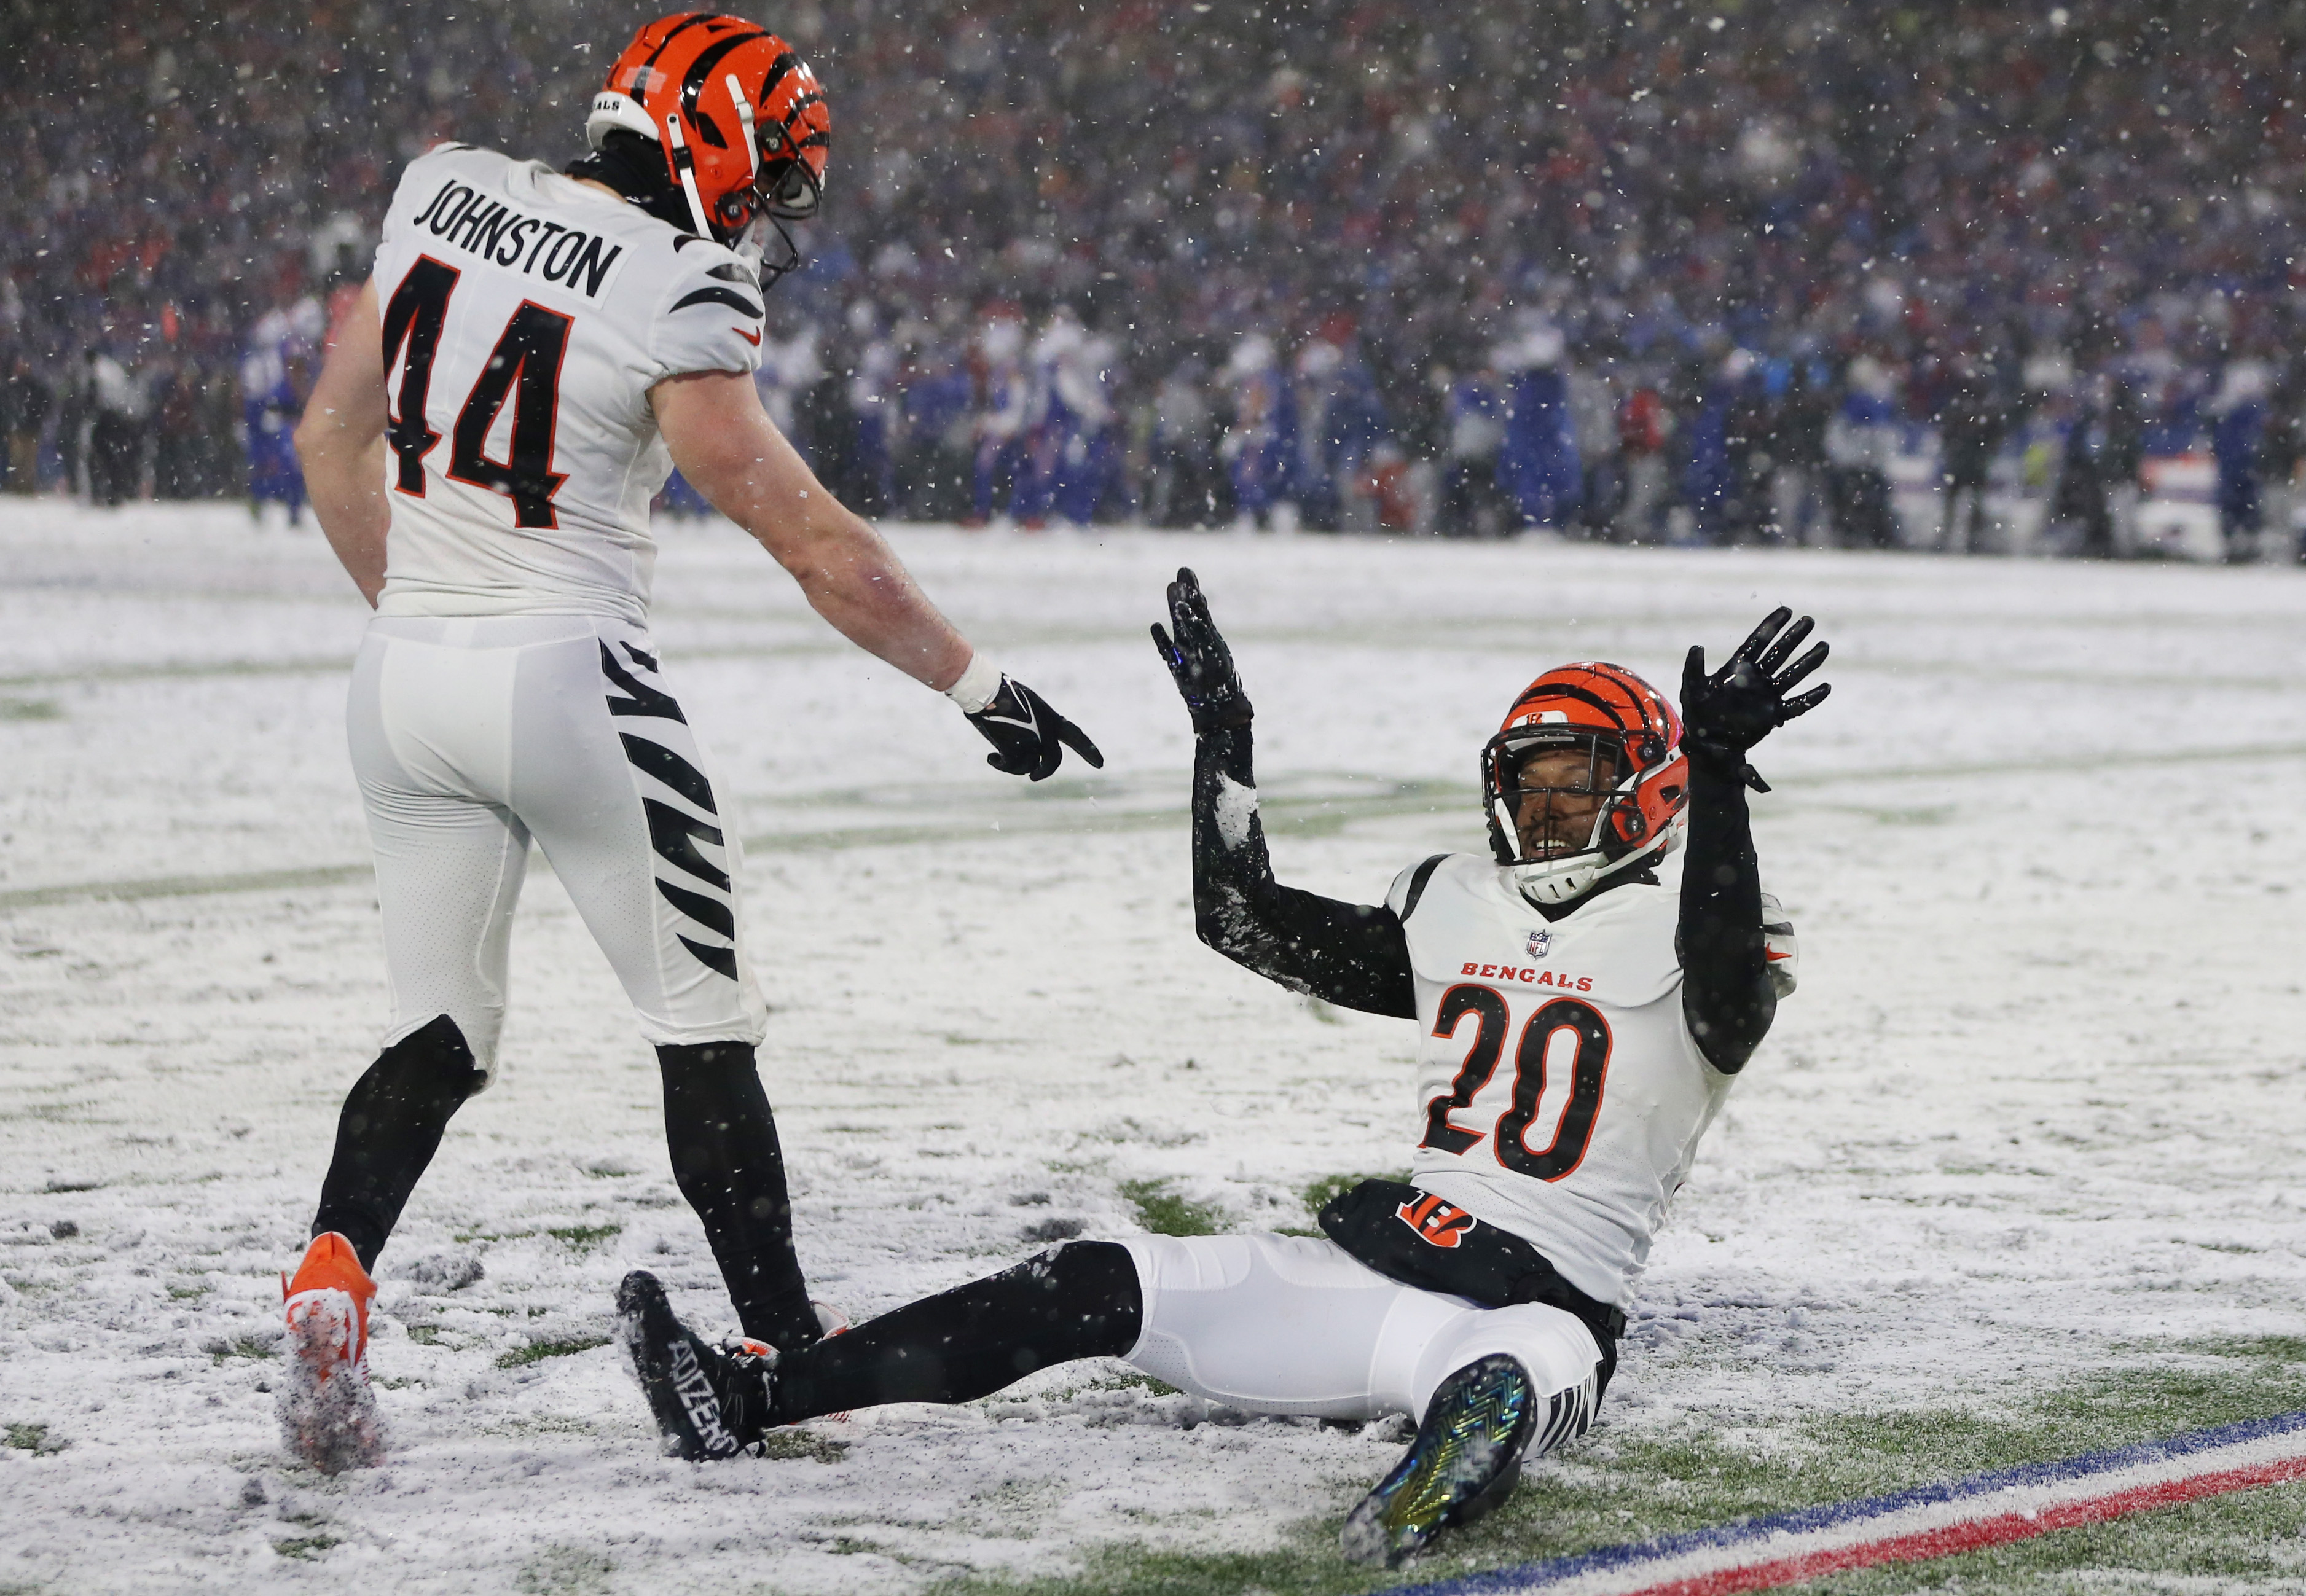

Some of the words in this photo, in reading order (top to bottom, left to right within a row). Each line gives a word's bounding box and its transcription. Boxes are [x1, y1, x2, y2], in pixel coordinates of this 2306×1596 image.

[594, 101, 619, 110] ALS
[414, 179, 621, 297] JOHNSTON
[382, 253, 575, 529] 44
[1461, 962, 1593, 992] BENGALS
[1529, 941, 1544, 954] NFL
[1418, 983, 1613, 1183] 20
